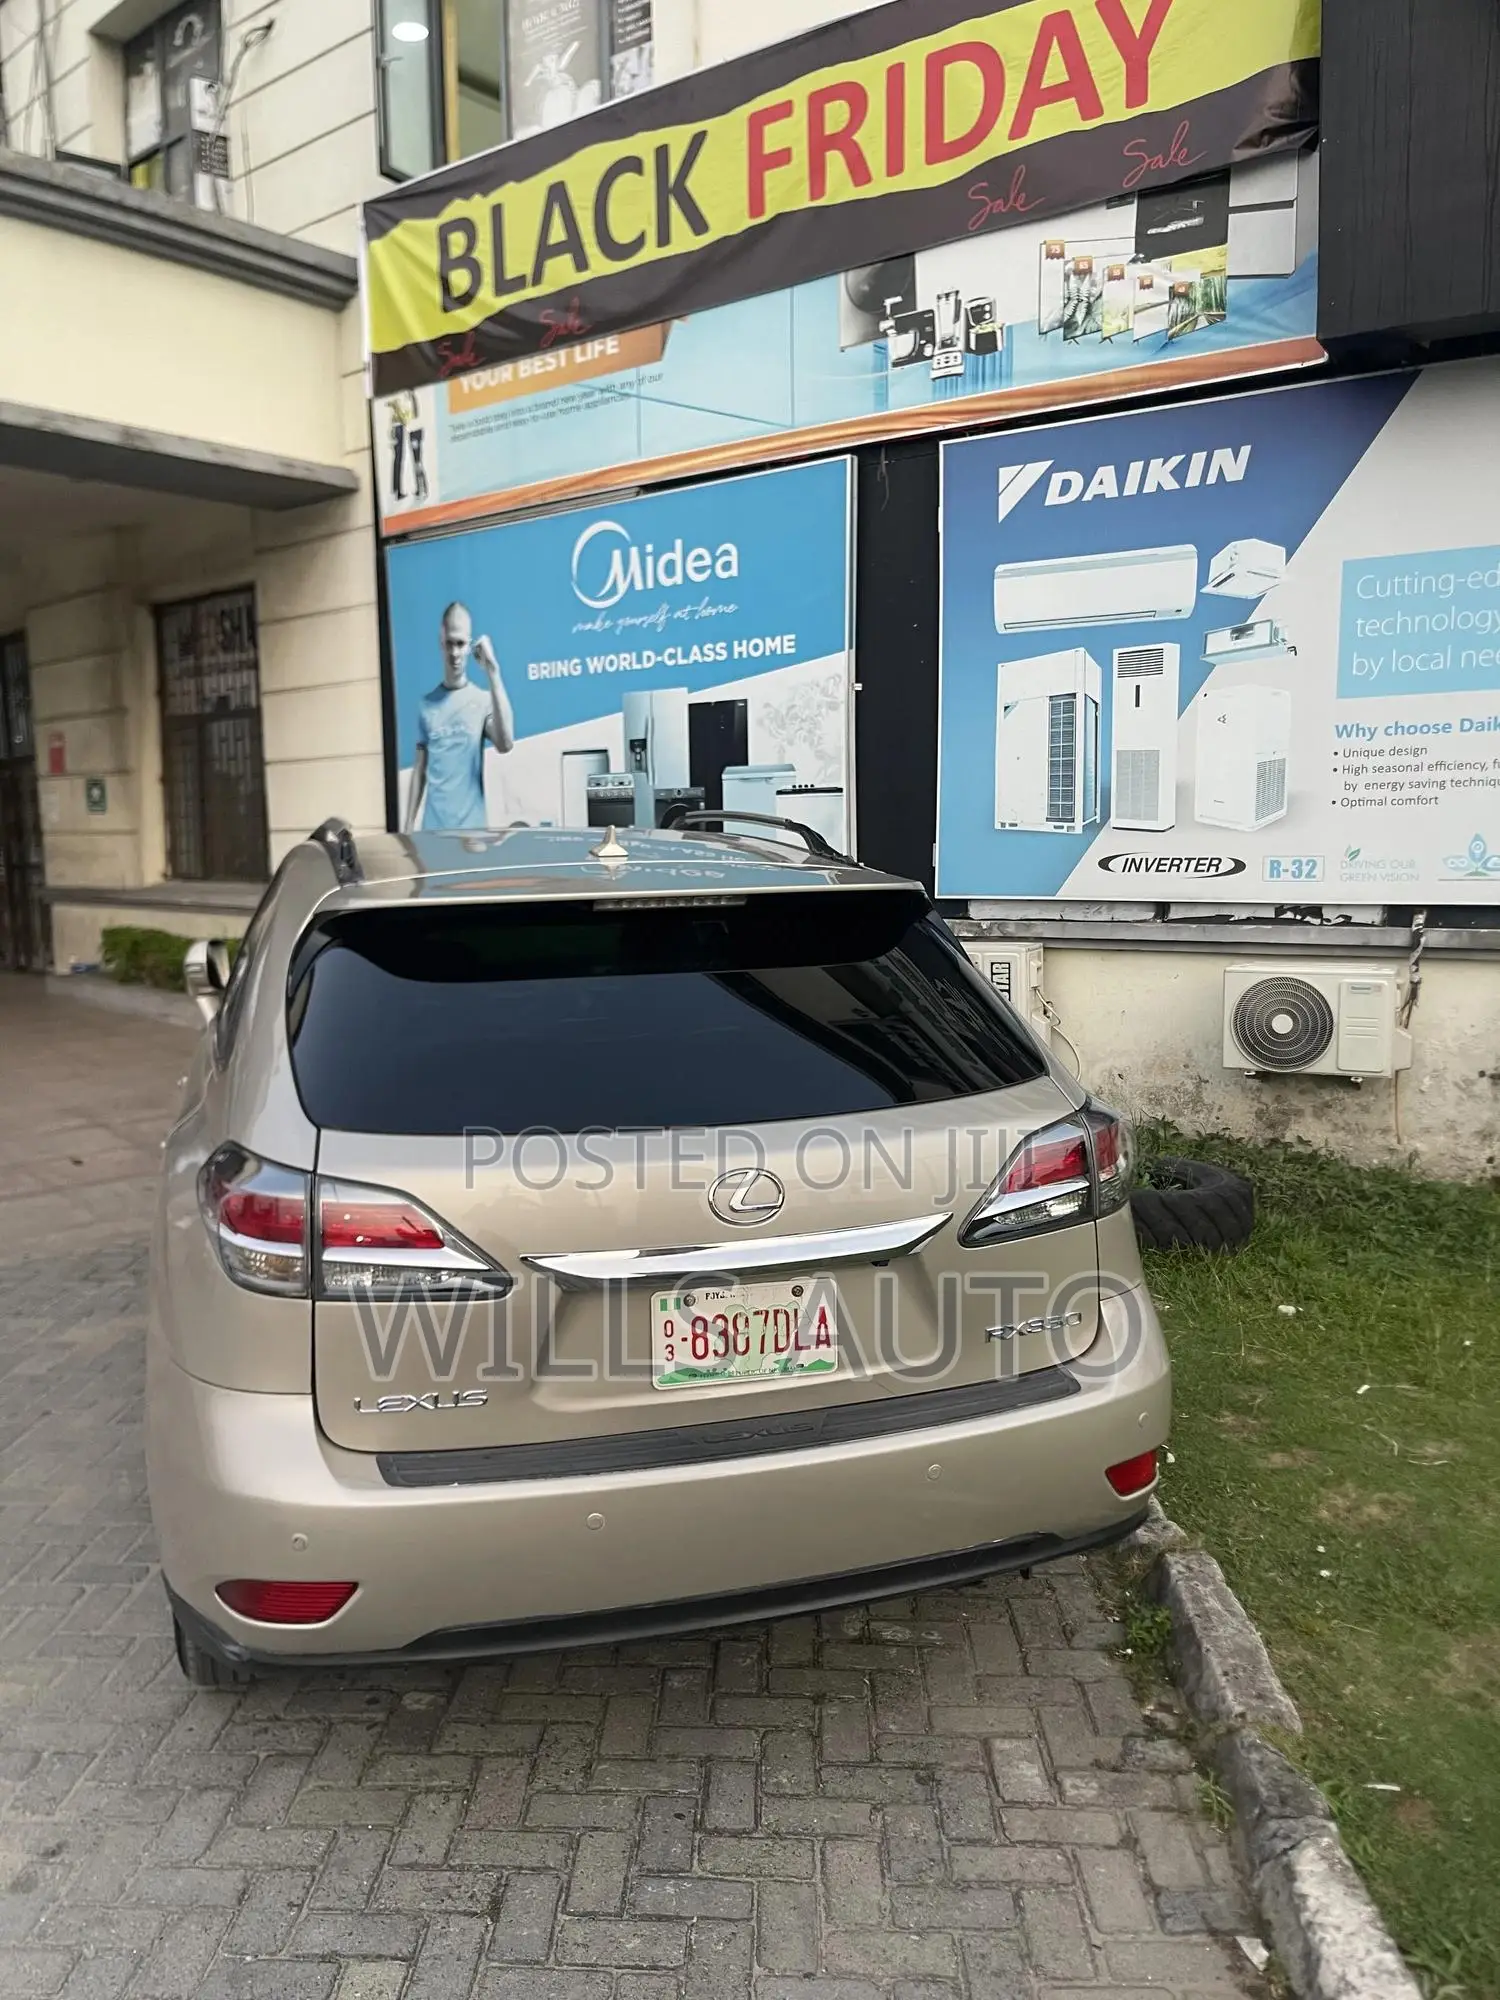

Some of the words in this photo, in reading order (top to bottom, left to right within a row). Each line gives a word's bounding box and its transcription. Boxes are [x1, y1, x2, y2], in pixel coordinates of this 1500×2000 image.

[438, 130, 709, 313] BLACK
[748, 0, 1173, 220] FRIDAY
[1123, 120, 1207, 187] Sale
[968, 164, 1045, 230] Sale
[459, 364, 514, 394] YOUR
[518, 348, 570, 379] BEST
[573, 335, 620, 363] LIFE
[1044, 445, 1252, 506] DAIKIN
[571, 521, 739, 609] Midea
[527, 658, 582, 681] BRING
[586, 642, 728, 674] WORLD-CLASS
[733, 634, 797, 659] HOME
[1352, 652, 1384, 681] by
[1392, 645, 1451, 673] local
[1335, 723, 1378, 742] Why
[1384, 721, 1452, 736] choose
[1343, 748, 1385, 759] Unique
[1388, 746, 1428, 757] design
[1343, 764, 1368, 776] High
[1372, 762, 1424, 774] seasonal
[1427, 760, 1489, 772] efficiency,
[1344, 781, 1358, 792] by
[1364, 781, 1405, 792] energy
[1408, 779, 1446, 790] saving
[1341, 797, 1387, 809] Optimal
[1391, 795, 1439, 806] comfort
[1122, 857, 1223, 873] INVERTER
[1269, 859, 1318, 879] R-32
[1340, 860, 1386, 869] DRIVING
[1340, 873, 1378, 882] GREEN
[1380, 873, 1420, 882] VISION
[353, 1389, 489, 1413] LEXUS
